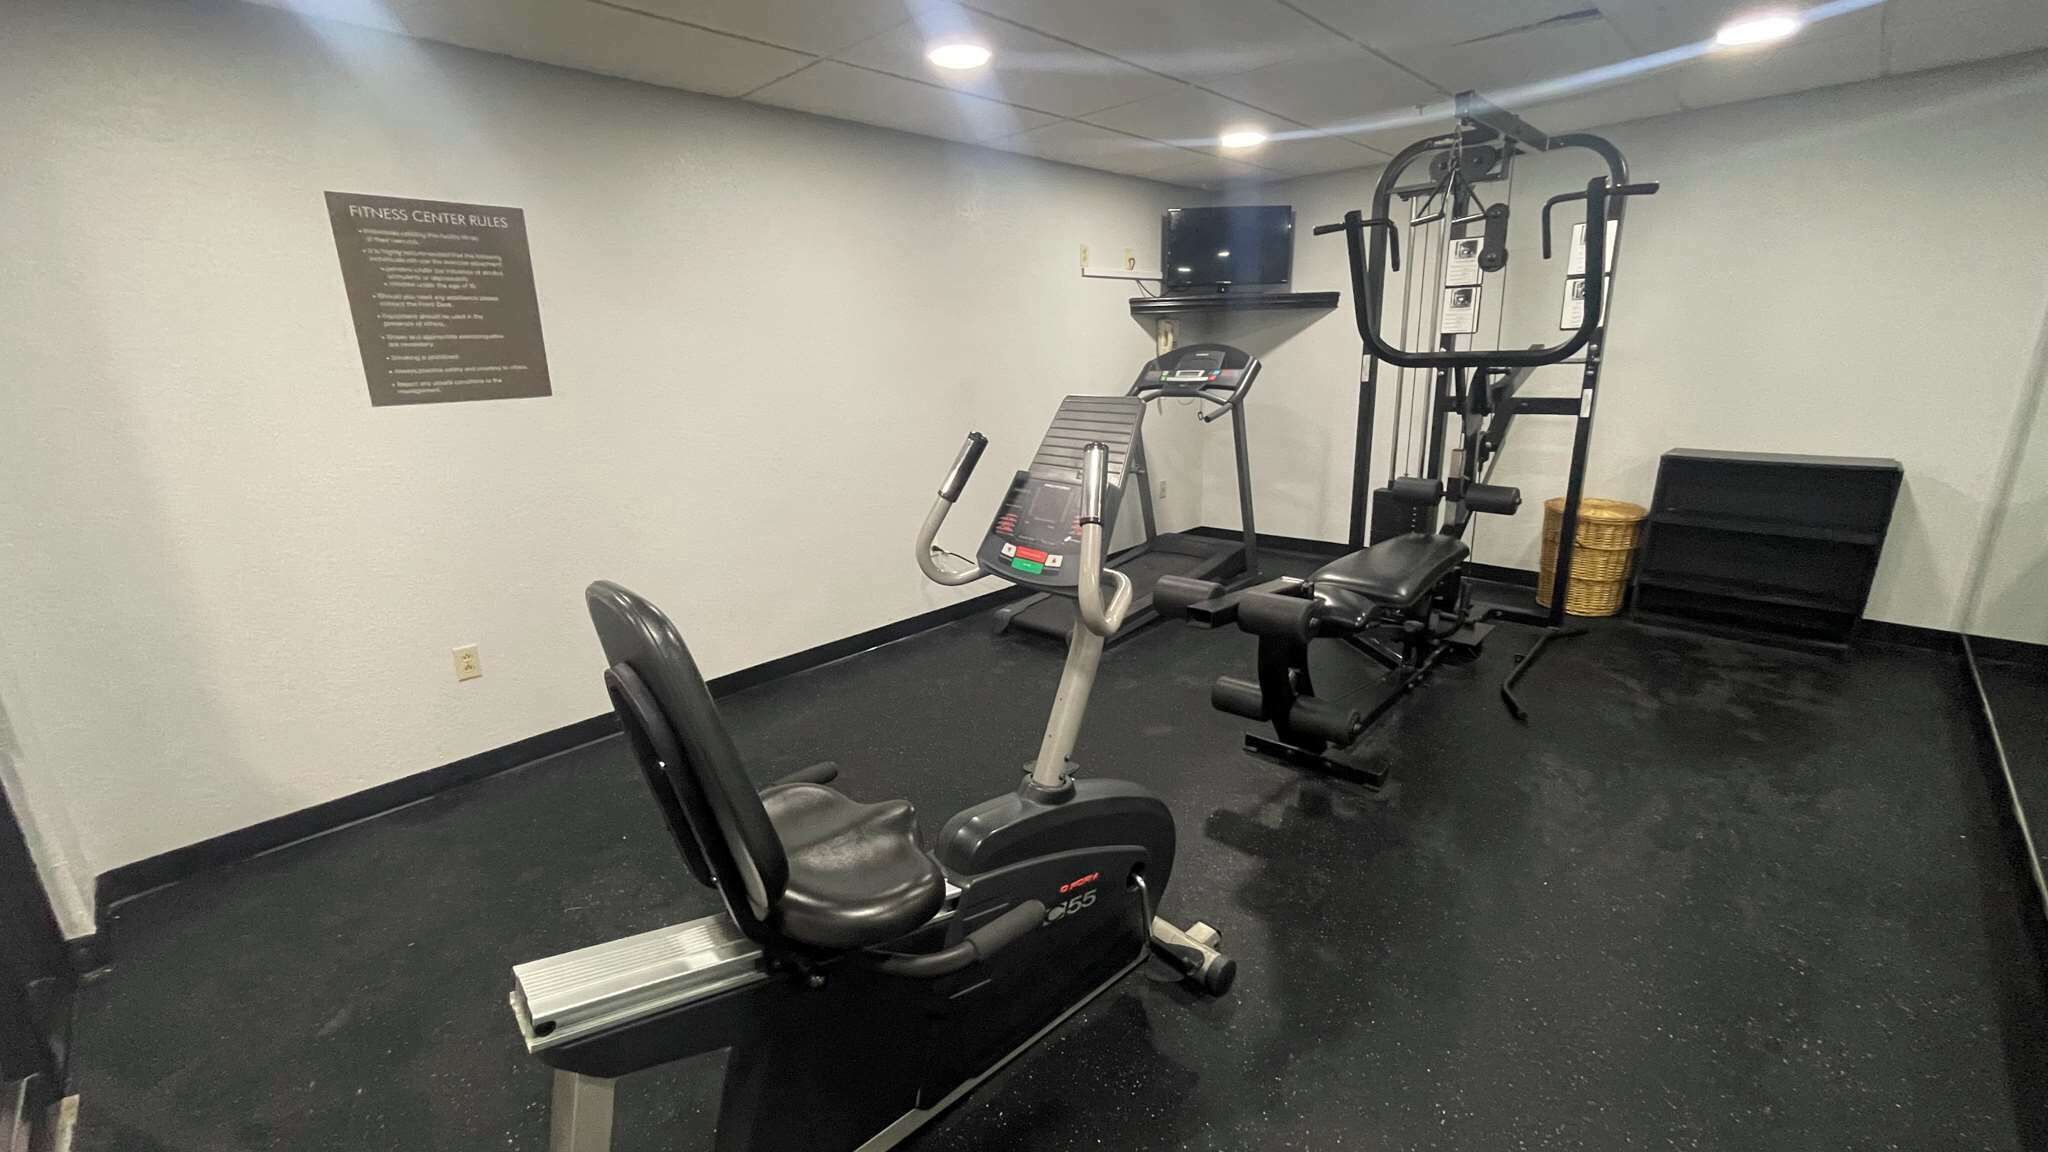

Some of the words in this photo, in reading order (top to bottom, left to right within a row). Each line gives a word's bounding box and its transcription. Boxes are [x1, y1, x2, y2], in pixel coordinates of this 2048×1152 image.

[348, 205, 408, 221] FITNESS
[411, 210, 466, 226] CENTER
[469, 215, 509, 229] RULES
